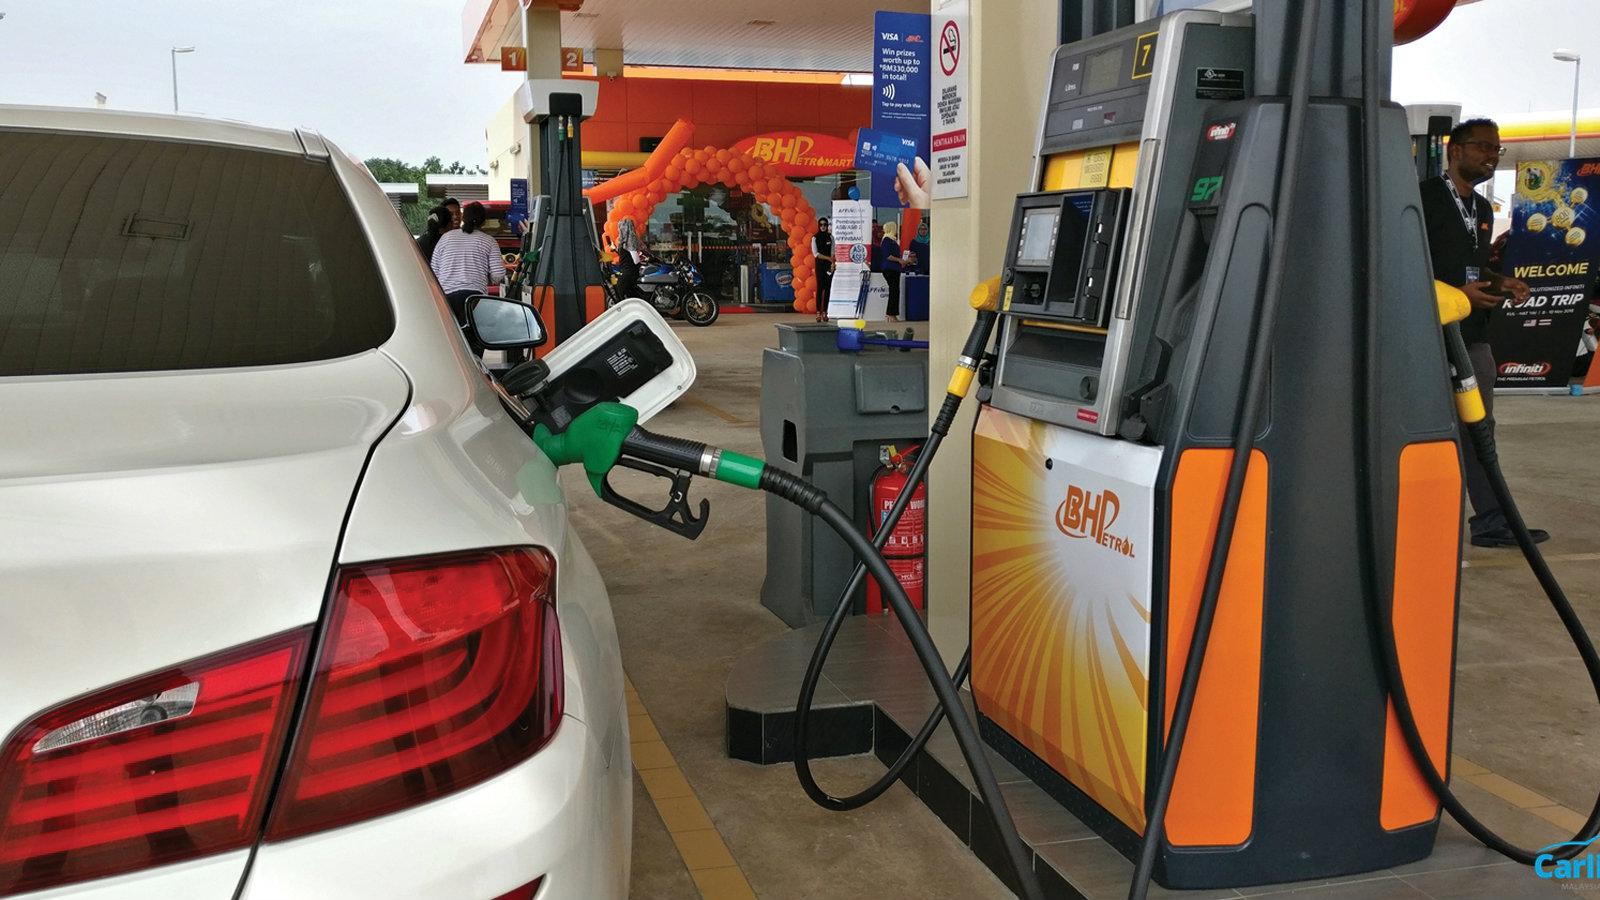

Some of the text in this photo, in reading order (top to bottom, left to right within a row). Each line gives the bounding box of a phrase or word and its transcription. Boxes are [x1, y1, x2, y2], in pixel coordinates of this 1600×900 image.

[881, 32, 899, 41] VISA
[882, 48, 916, 57] Win prizes
[1142, 44, 1151, 66] 7
[508, 52, 517, 66] 1
[566, 52, 578, 67] 2
[882, 57, 902, 65] worth
[913, 58, 920, 66] to
[889, 73, 907, 81] total!
[901, 138, 915, 147] VISA
[1190, 176, 1224, 203] 97
[1513, 262, 1590, 279] WELCOME
[1550, 293, 1585, 306] TRIP
[1504, 362, 1544, 374] infiniti
